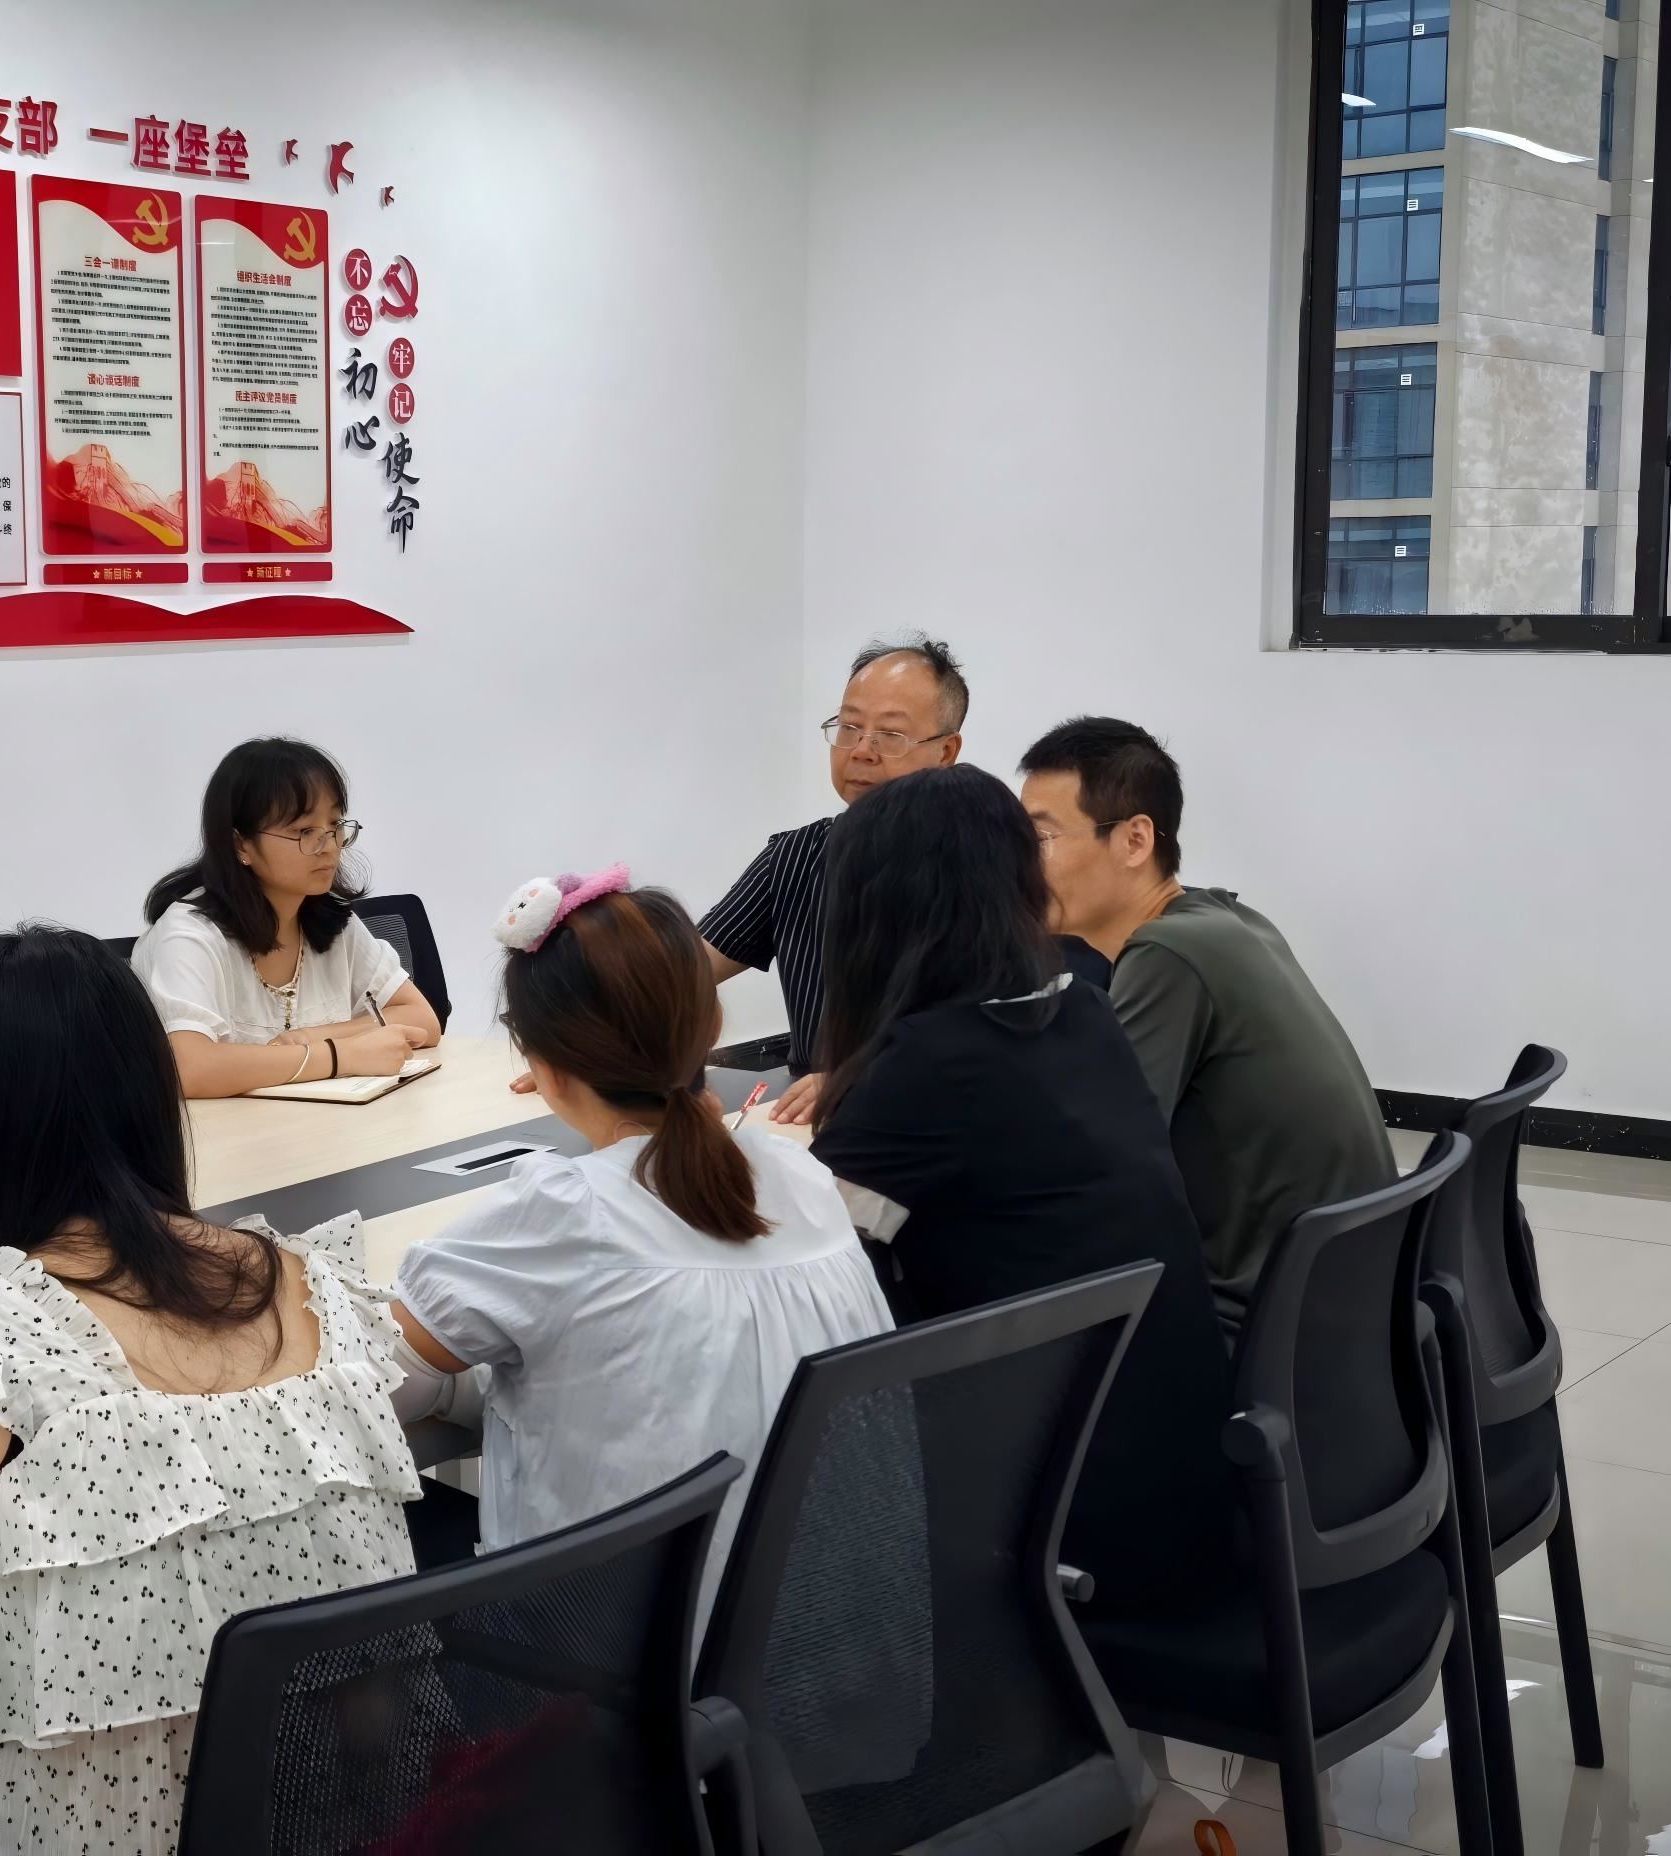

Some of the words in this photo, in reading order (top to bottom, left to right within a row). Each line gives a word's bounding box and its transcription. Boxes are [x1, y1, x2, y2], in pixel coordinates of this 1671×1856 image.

[88, 114, 250, 181] 一座堡垒
[339, 254, 380, 451] 不忘初心
[381, 342, 420, 554] 牢记使命
